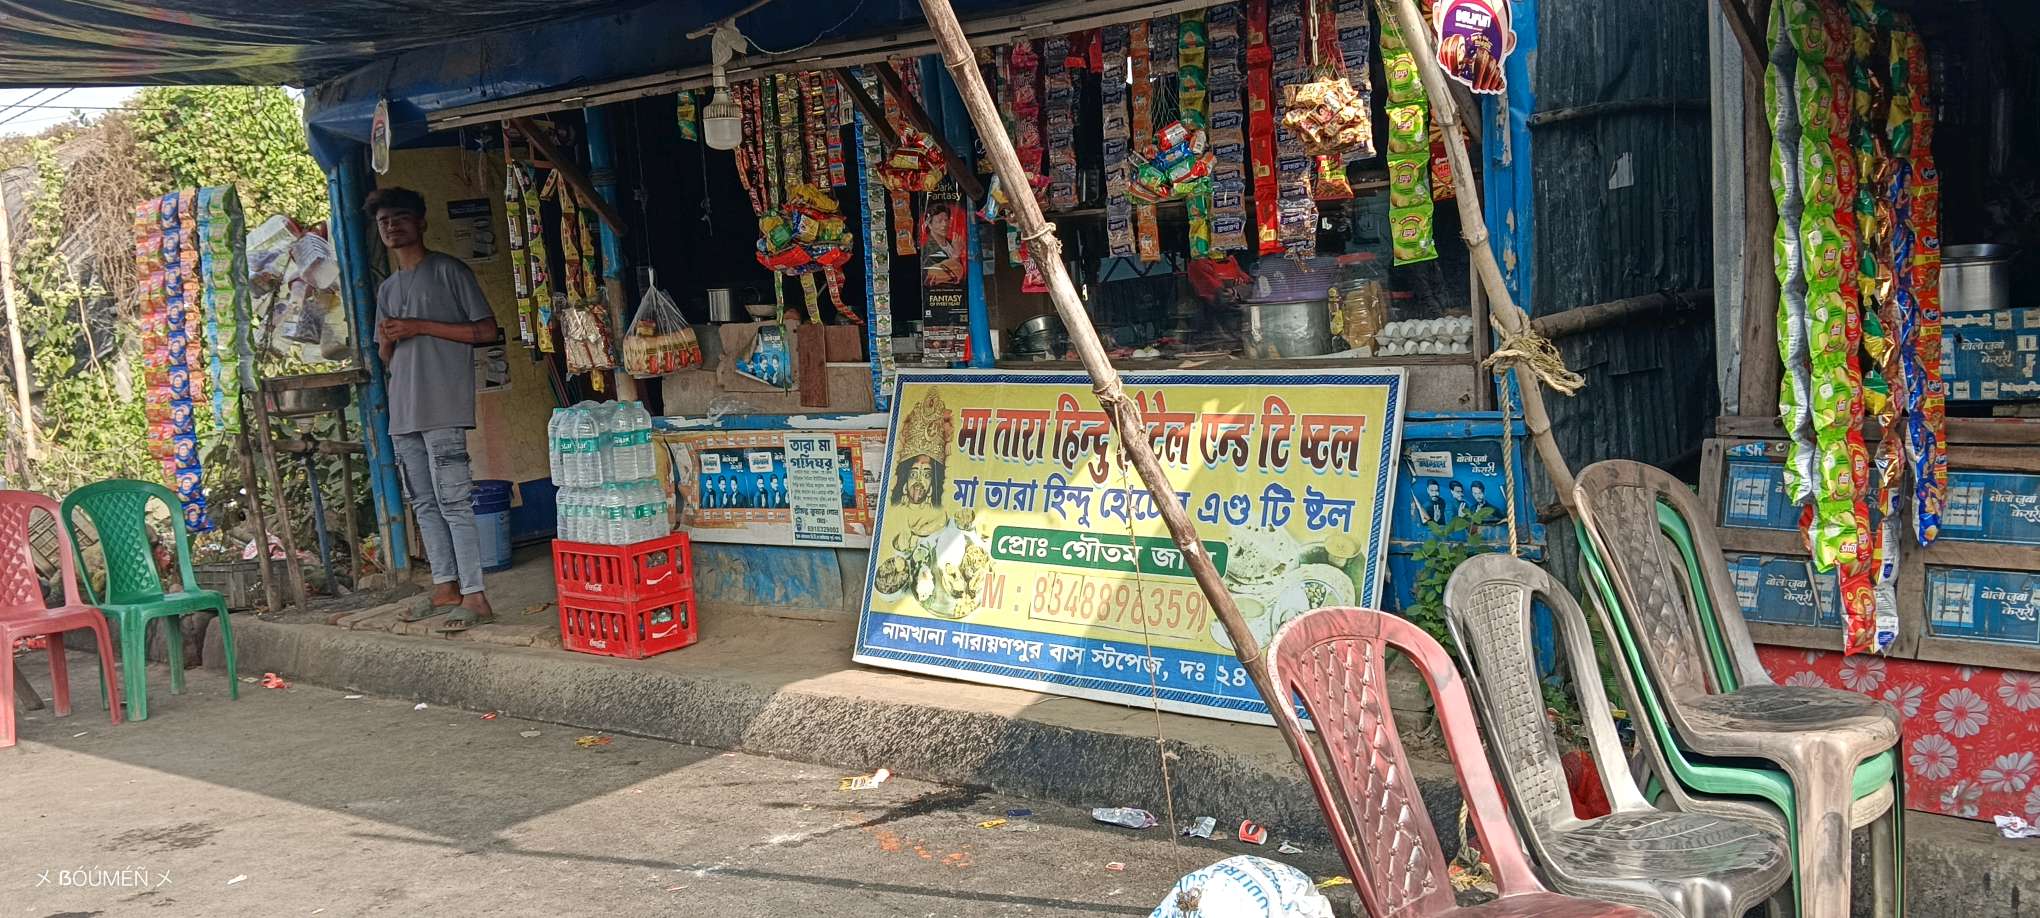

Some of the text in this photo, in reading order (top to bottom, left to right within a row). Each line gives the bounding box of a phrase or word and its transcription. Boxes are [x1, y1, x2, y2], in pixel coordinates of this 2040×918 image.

[926, 191, 962, 201] Fantasy
[930, 294, 962, 302] FANTASY
[789, 440, 815, 453] তারা
[818, 440, 831, 452] মা
[958, 409, 992, 457] मा
[993, 409, 1050, 461] तारा
[1258, 395, 1295, 468] टि
[954, 477, 978, 508] মা
[985, 478, 1038, 512] তারা
[1044, 473, 1093, 528] হিন্দু
[1260, 483, 1294, 528] টি
[982, 574, 1005, 609] M
[883, 622, 947, 646] নামখানা
[1050, 643, 1085, 665] বাস
